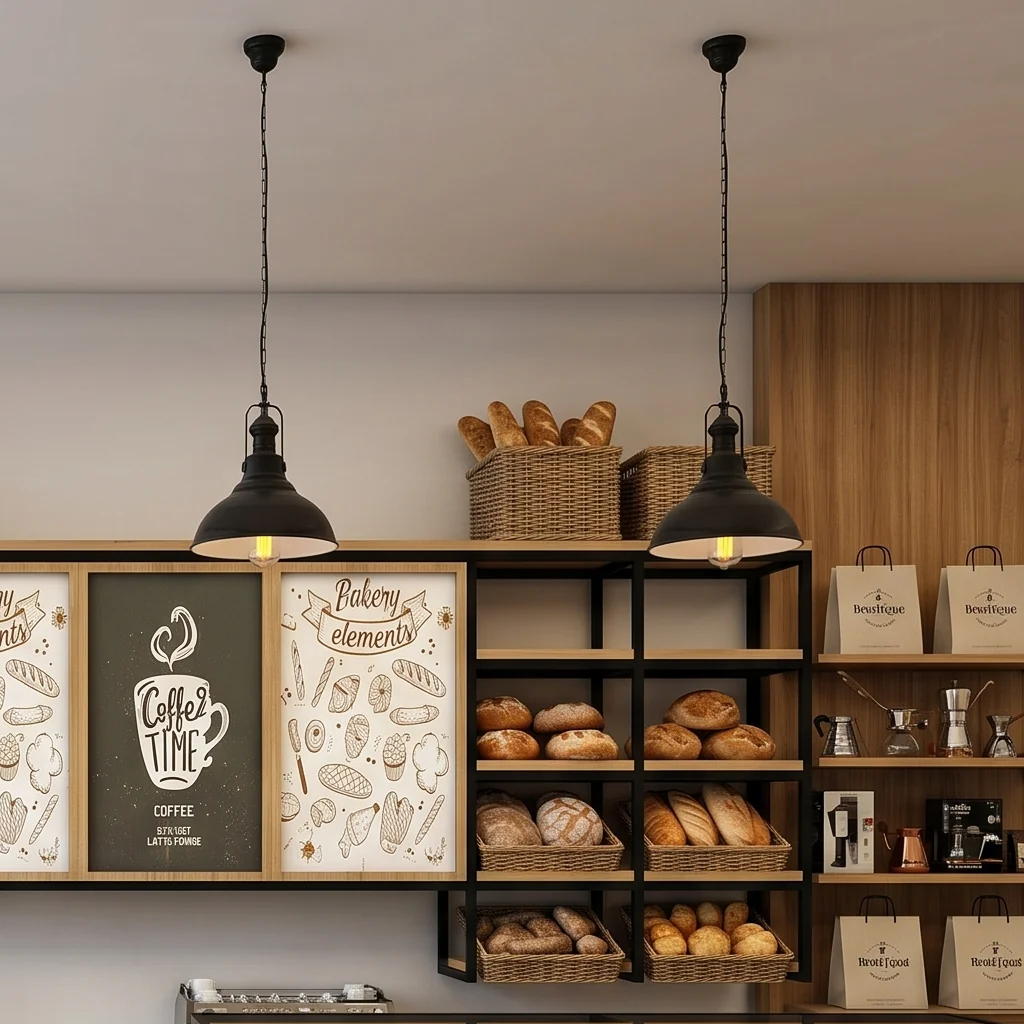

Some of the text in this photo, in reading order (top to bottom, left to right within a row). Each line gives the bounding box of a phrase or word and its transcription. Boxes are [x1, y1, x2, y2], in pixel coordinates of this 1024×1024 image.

[335, 577, 400, 617] Bakery
[332, 620, 414, 649] elements
[144, 728, 199, 773] TIME
[154, 804, 195, 817] COFFEE
